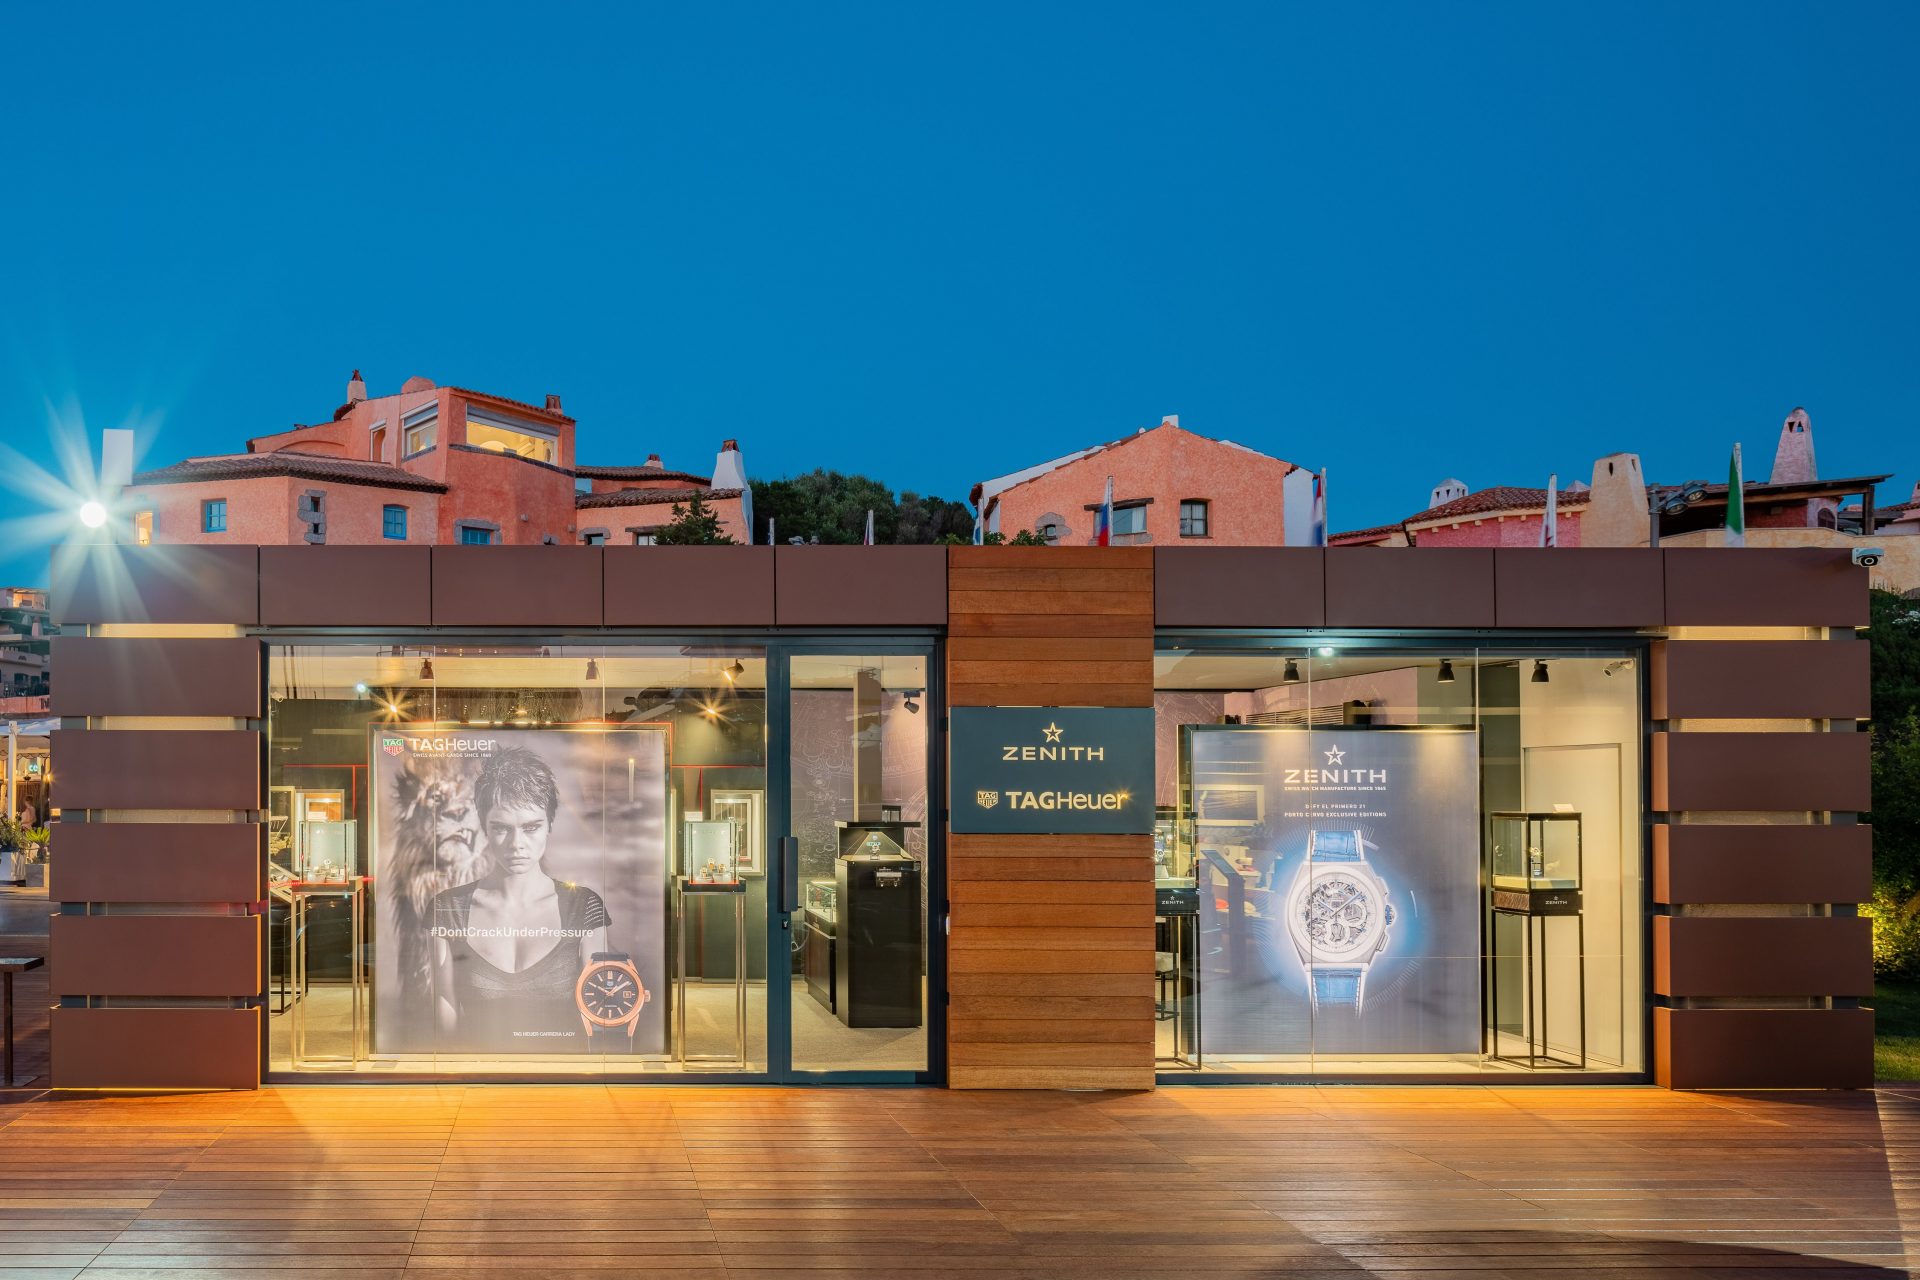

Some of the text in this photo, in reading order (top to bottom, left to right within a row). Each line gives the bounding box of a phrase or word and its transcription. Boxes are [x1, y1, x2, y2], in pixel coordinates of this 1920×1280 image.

[1002, 746, 1105, 761] ZENITH
[1284, 769, 1387, 783] ZENITH
[978, 791, 999, 799] TAG
[430, 926, 594, 938] #DontCrackUnderPressure
